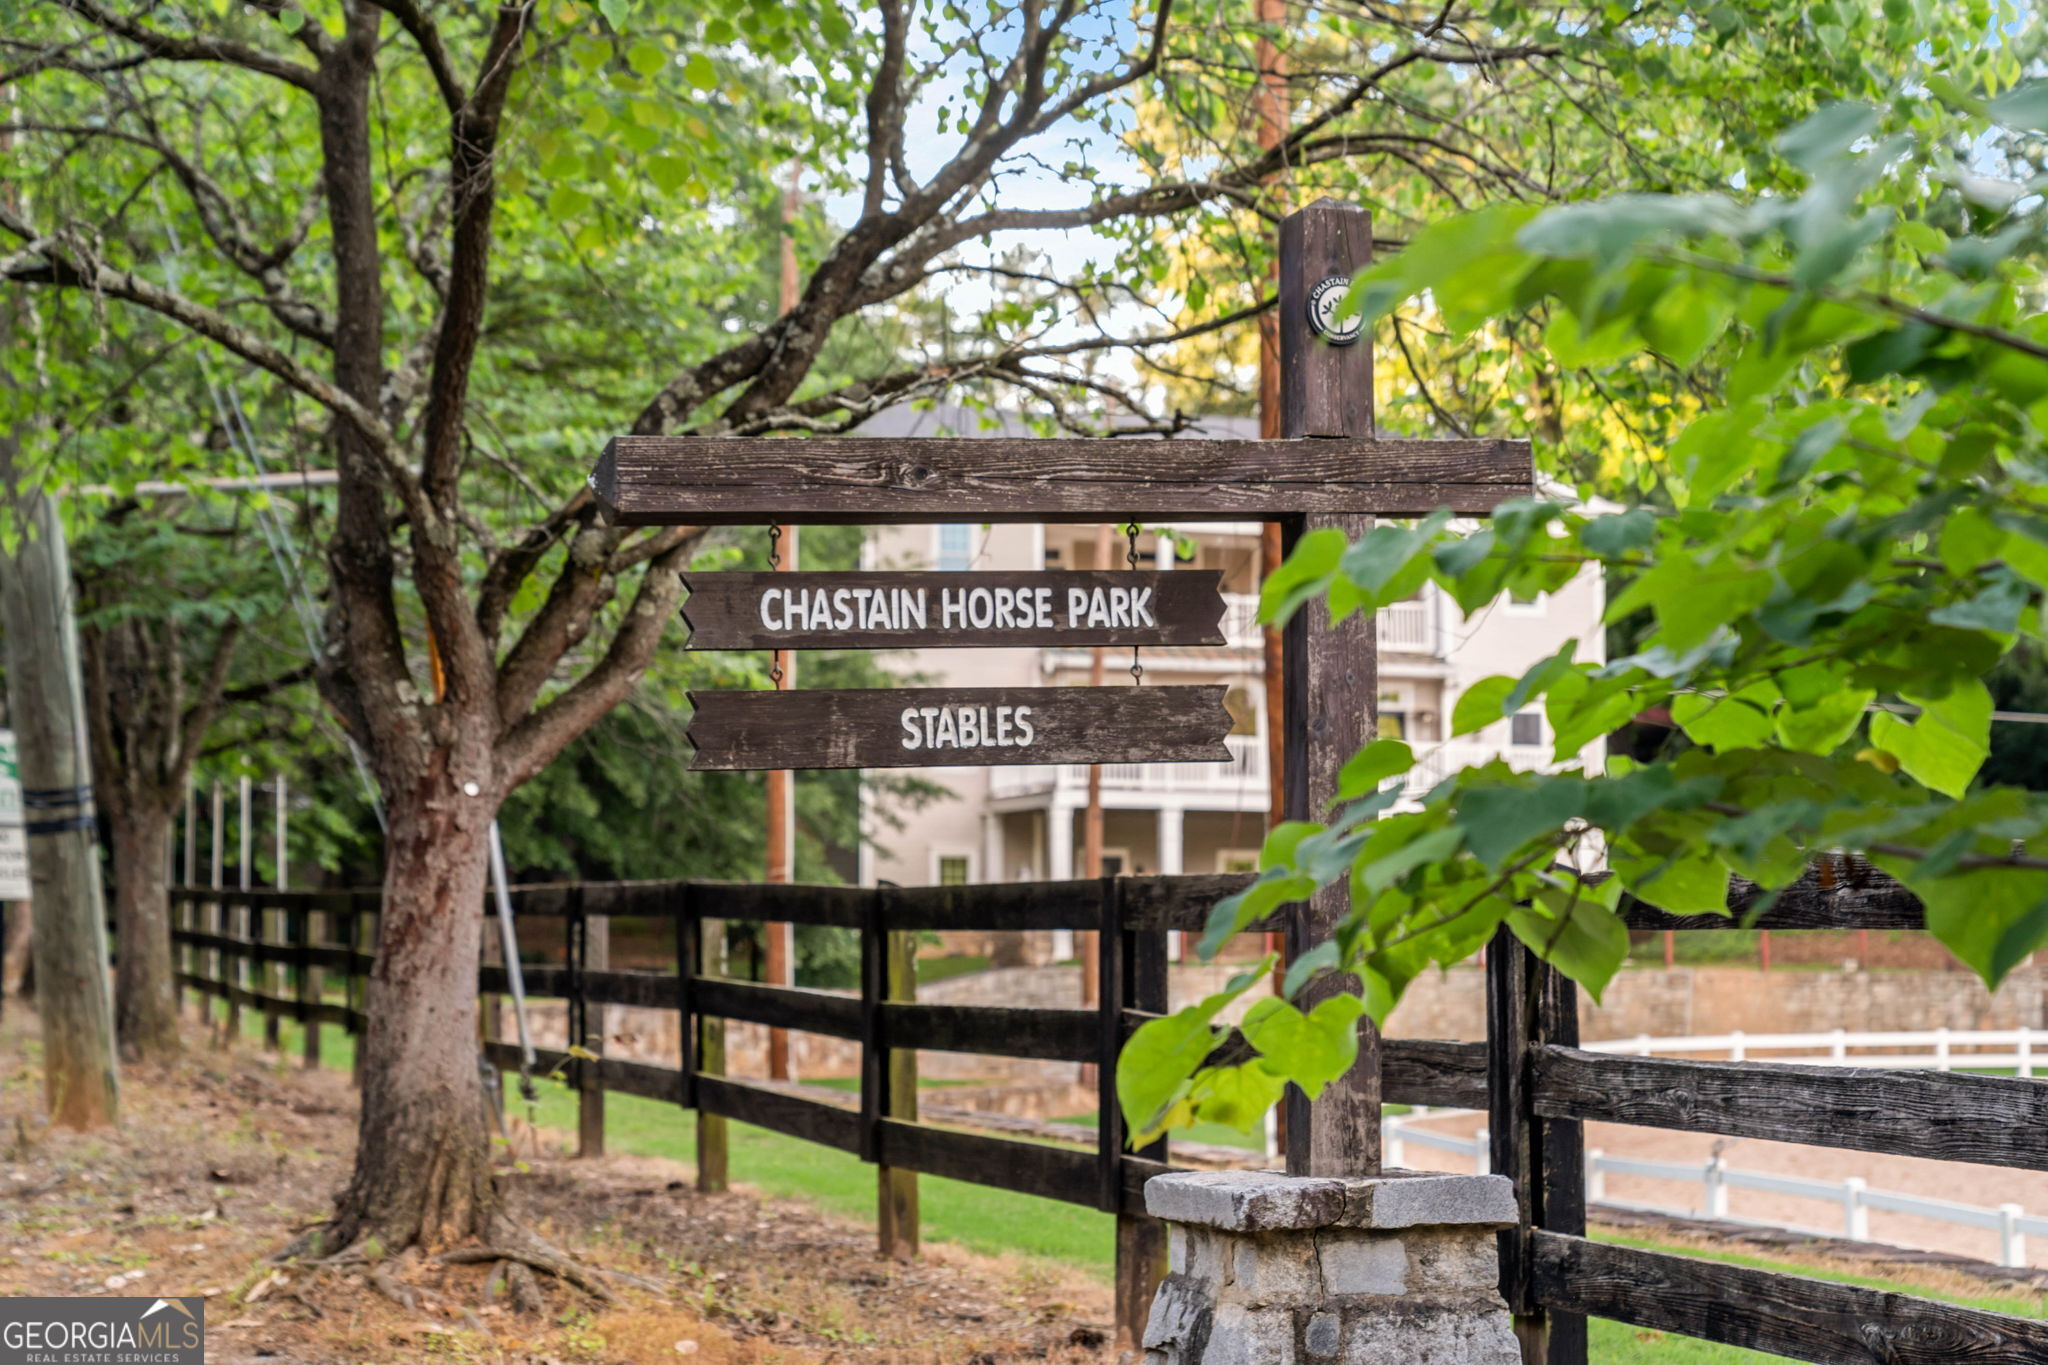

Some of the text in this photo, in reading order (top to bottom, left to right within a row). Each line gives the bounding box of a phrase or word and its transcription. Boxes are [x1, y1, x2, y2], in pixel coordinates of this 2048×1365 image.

[1312, 277, 1350, 299] CHASTAIN
[759, 586, 1154, 631] CHASTAIN HORSE PARK
[901, 705, 1034, 750] STABLES
